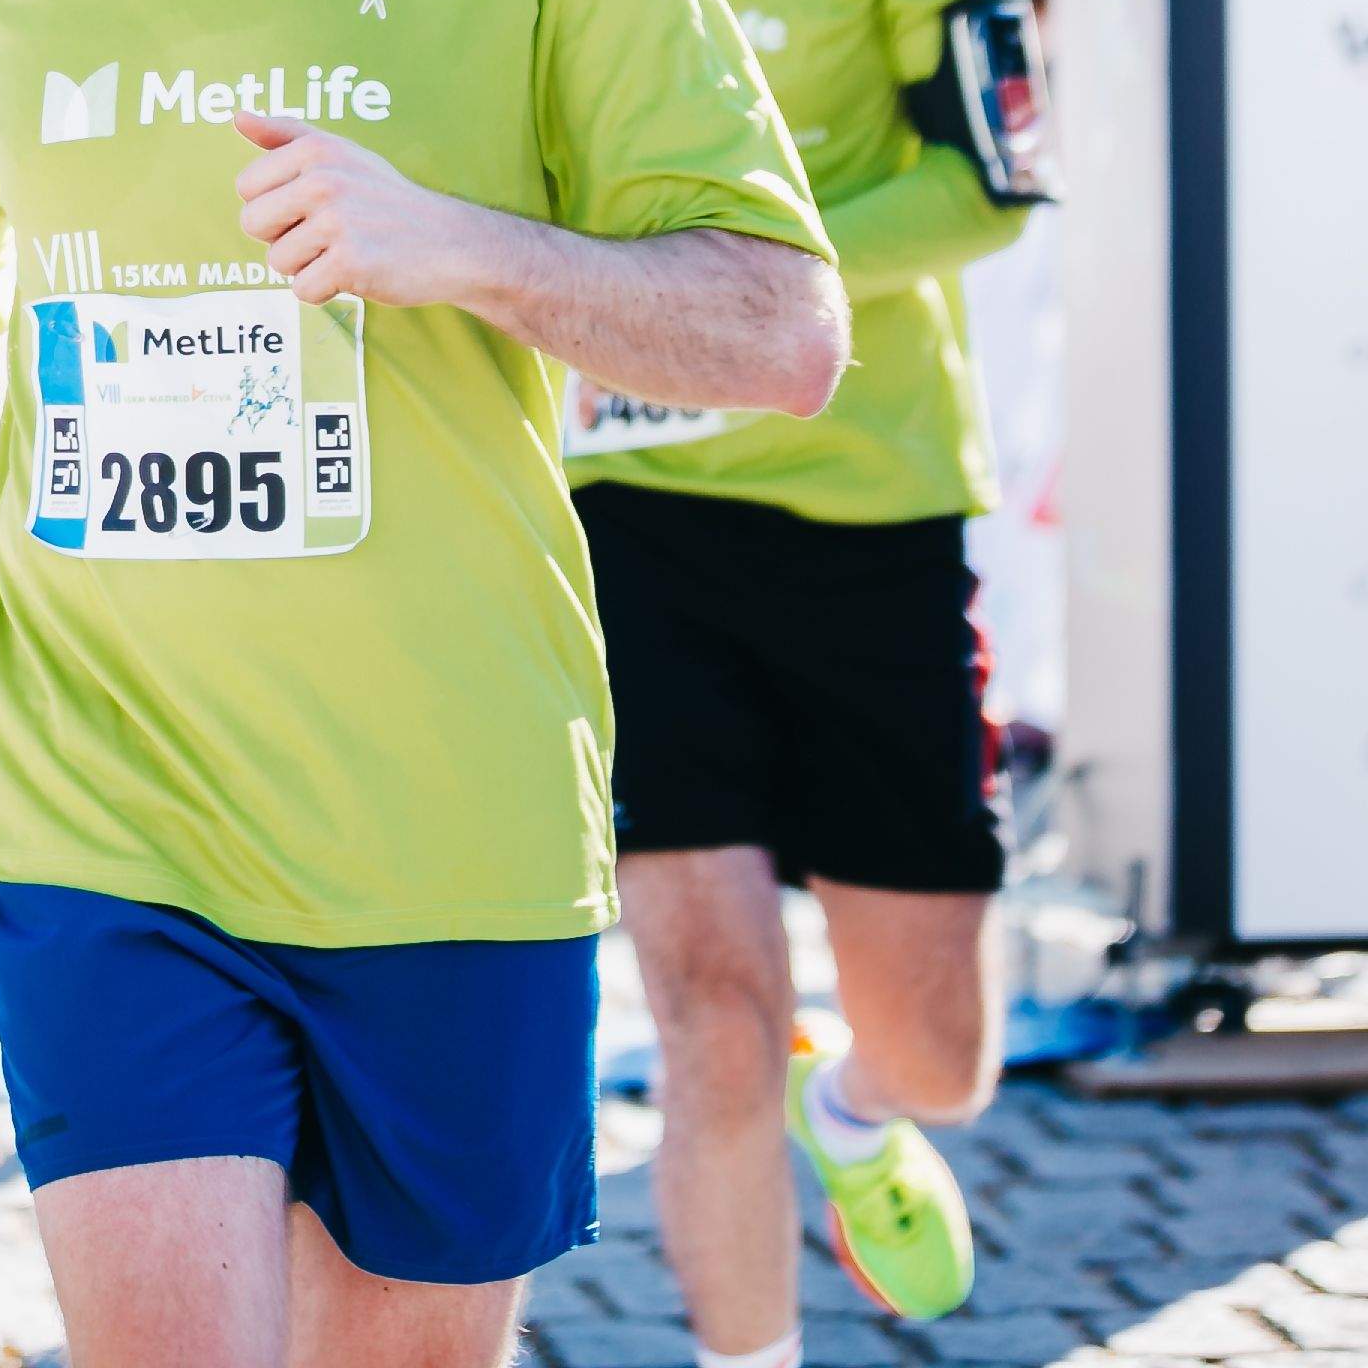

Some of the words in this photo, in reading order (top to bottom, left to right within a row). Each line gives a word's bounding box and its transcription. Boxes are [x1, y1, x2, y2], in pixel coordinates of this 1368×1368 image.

[139, 65, 391, 124] MetLife
[32, 230, 103, 293] VIII
[112, 264, 187, 288] 15KM
[142, 324, 283, 356] MetLife
[101, 451, 286, 533] 2895
